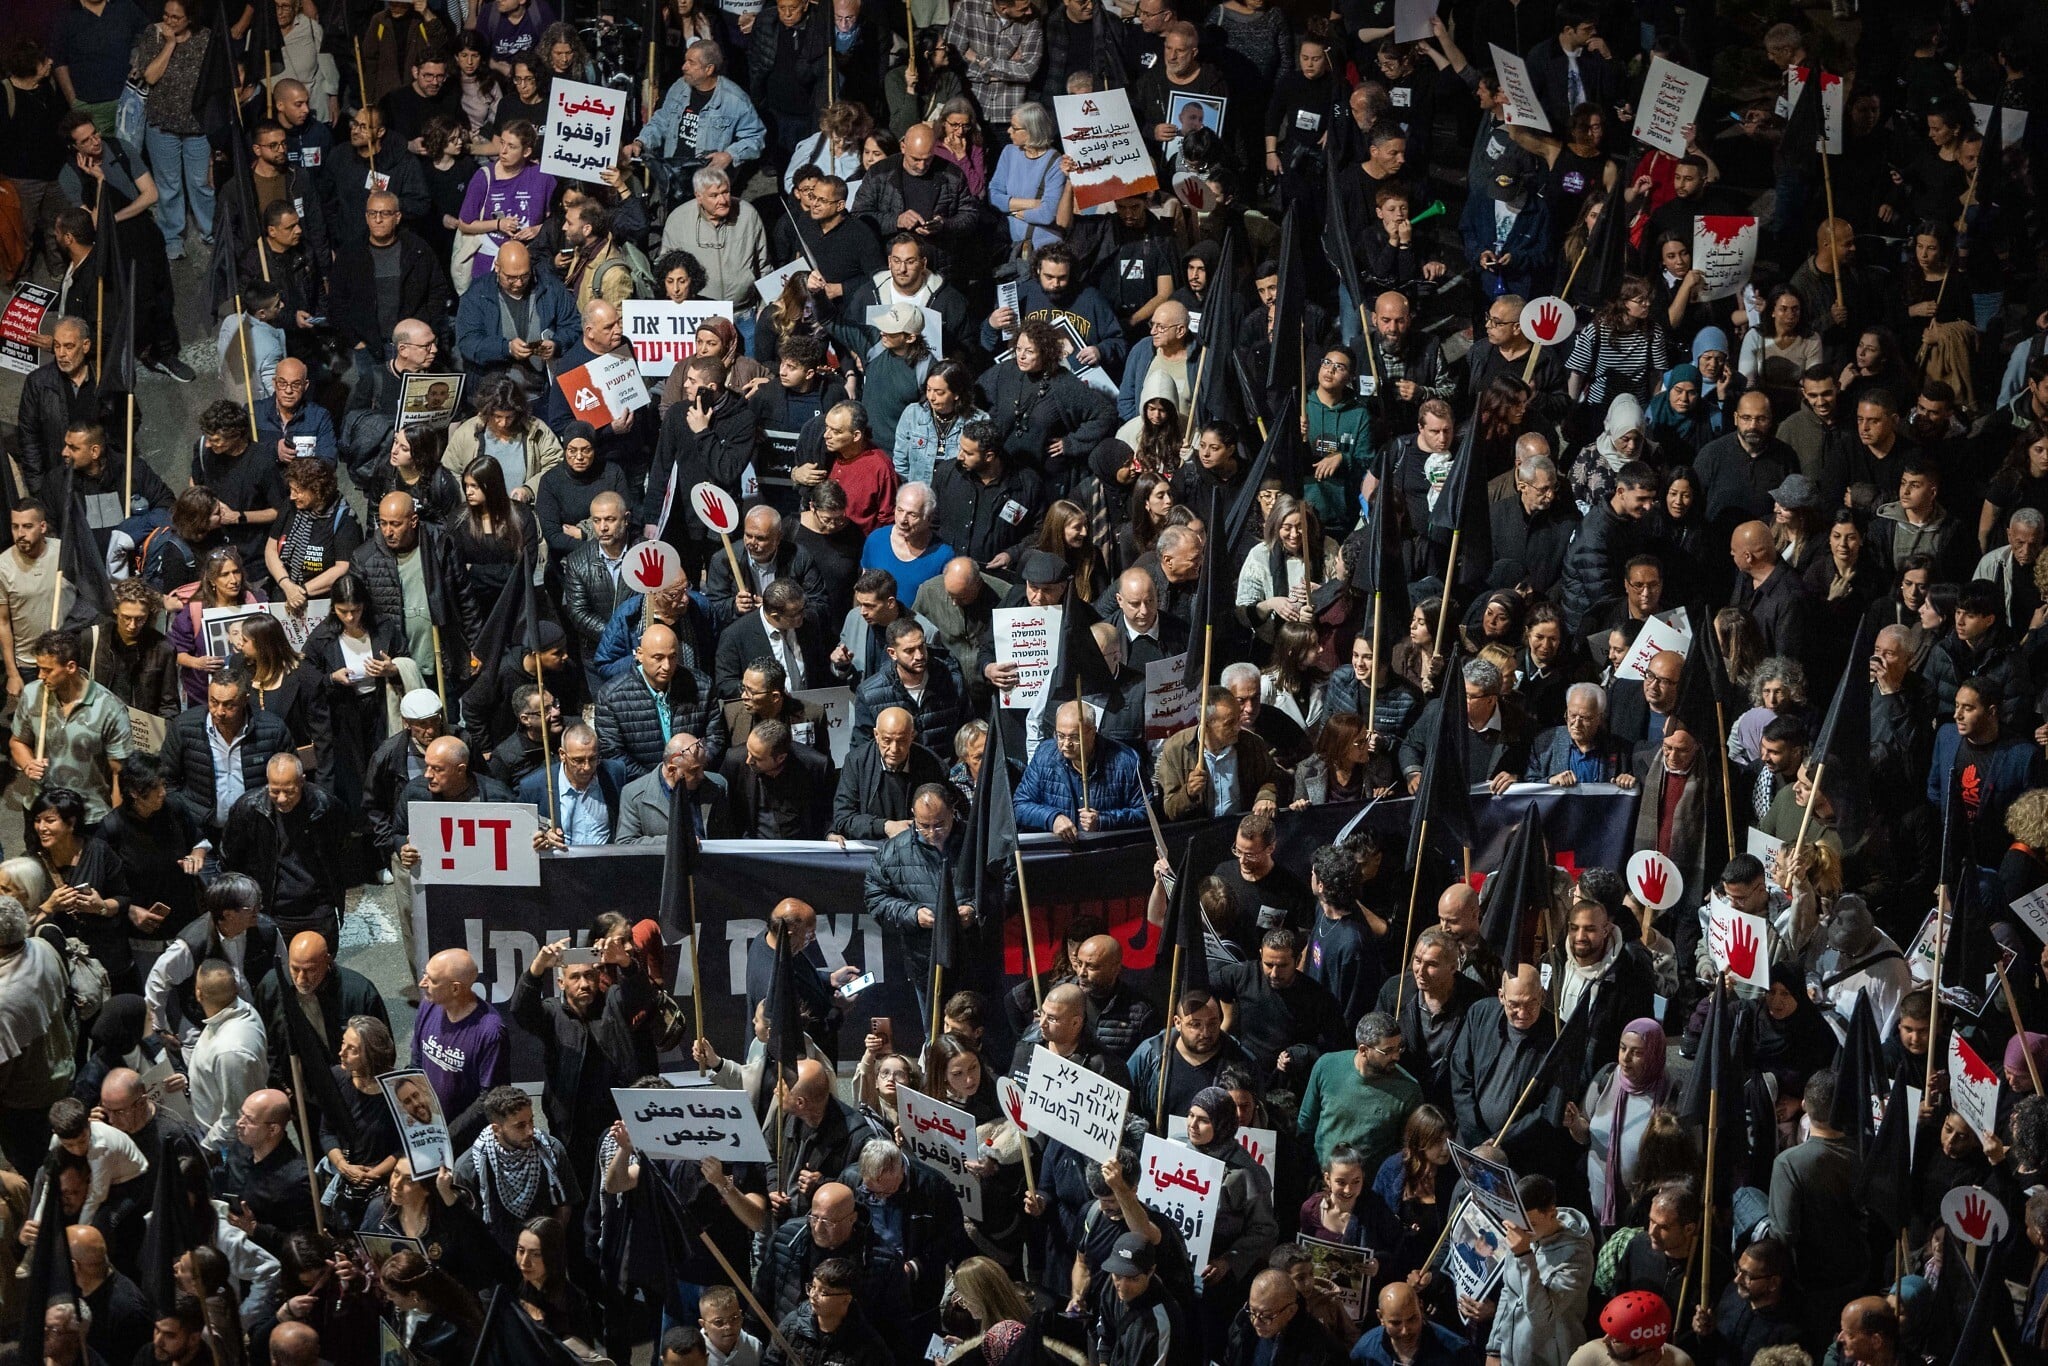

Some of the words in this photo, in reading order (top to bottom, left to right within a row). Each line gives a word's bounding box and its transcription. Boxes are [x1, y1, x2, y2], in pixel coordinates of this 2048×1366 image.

[558, 92, 616, 121] بكفي!
[556, 121, 611, 148] أوقفوا
[1114, 148, 1141, 165] ليس
[632, 316, 659, 334] את
[627, 368, 637, 380] לא
[1011, 617, 1045, 629] الحكومة
[1011, 629, 1047, 638] הממשלה
[1011, 649, 1049, 658] והמשטרה
[1012, 638, 1047, 648] والشرطة
[440, 817, 511, 871] די!
[2022, 902, 2048, 928] FOR
[1042, 1074, 1062, 1092] יד
[1058, 1063, 1079, 1084] לא
[1089, 1083, 1122, 1107] זאת
[634, 1101, 684, 1123] مش
[687, 1103, 743, 1120] دمنا
[1028, 1090, 1080, 1128] המטרה
[1067, 1091, 1119, 1126] אוזלת
[906, 1103, 967, 1146] بكفي!
[1083, 1122, 1117, 1150] זאת
[911, 1136, 969, 1175] أوقفوا
[1148, 1156, 1211, 1202] بكفي!
[1630, 1322, 1667, 1340] dott
